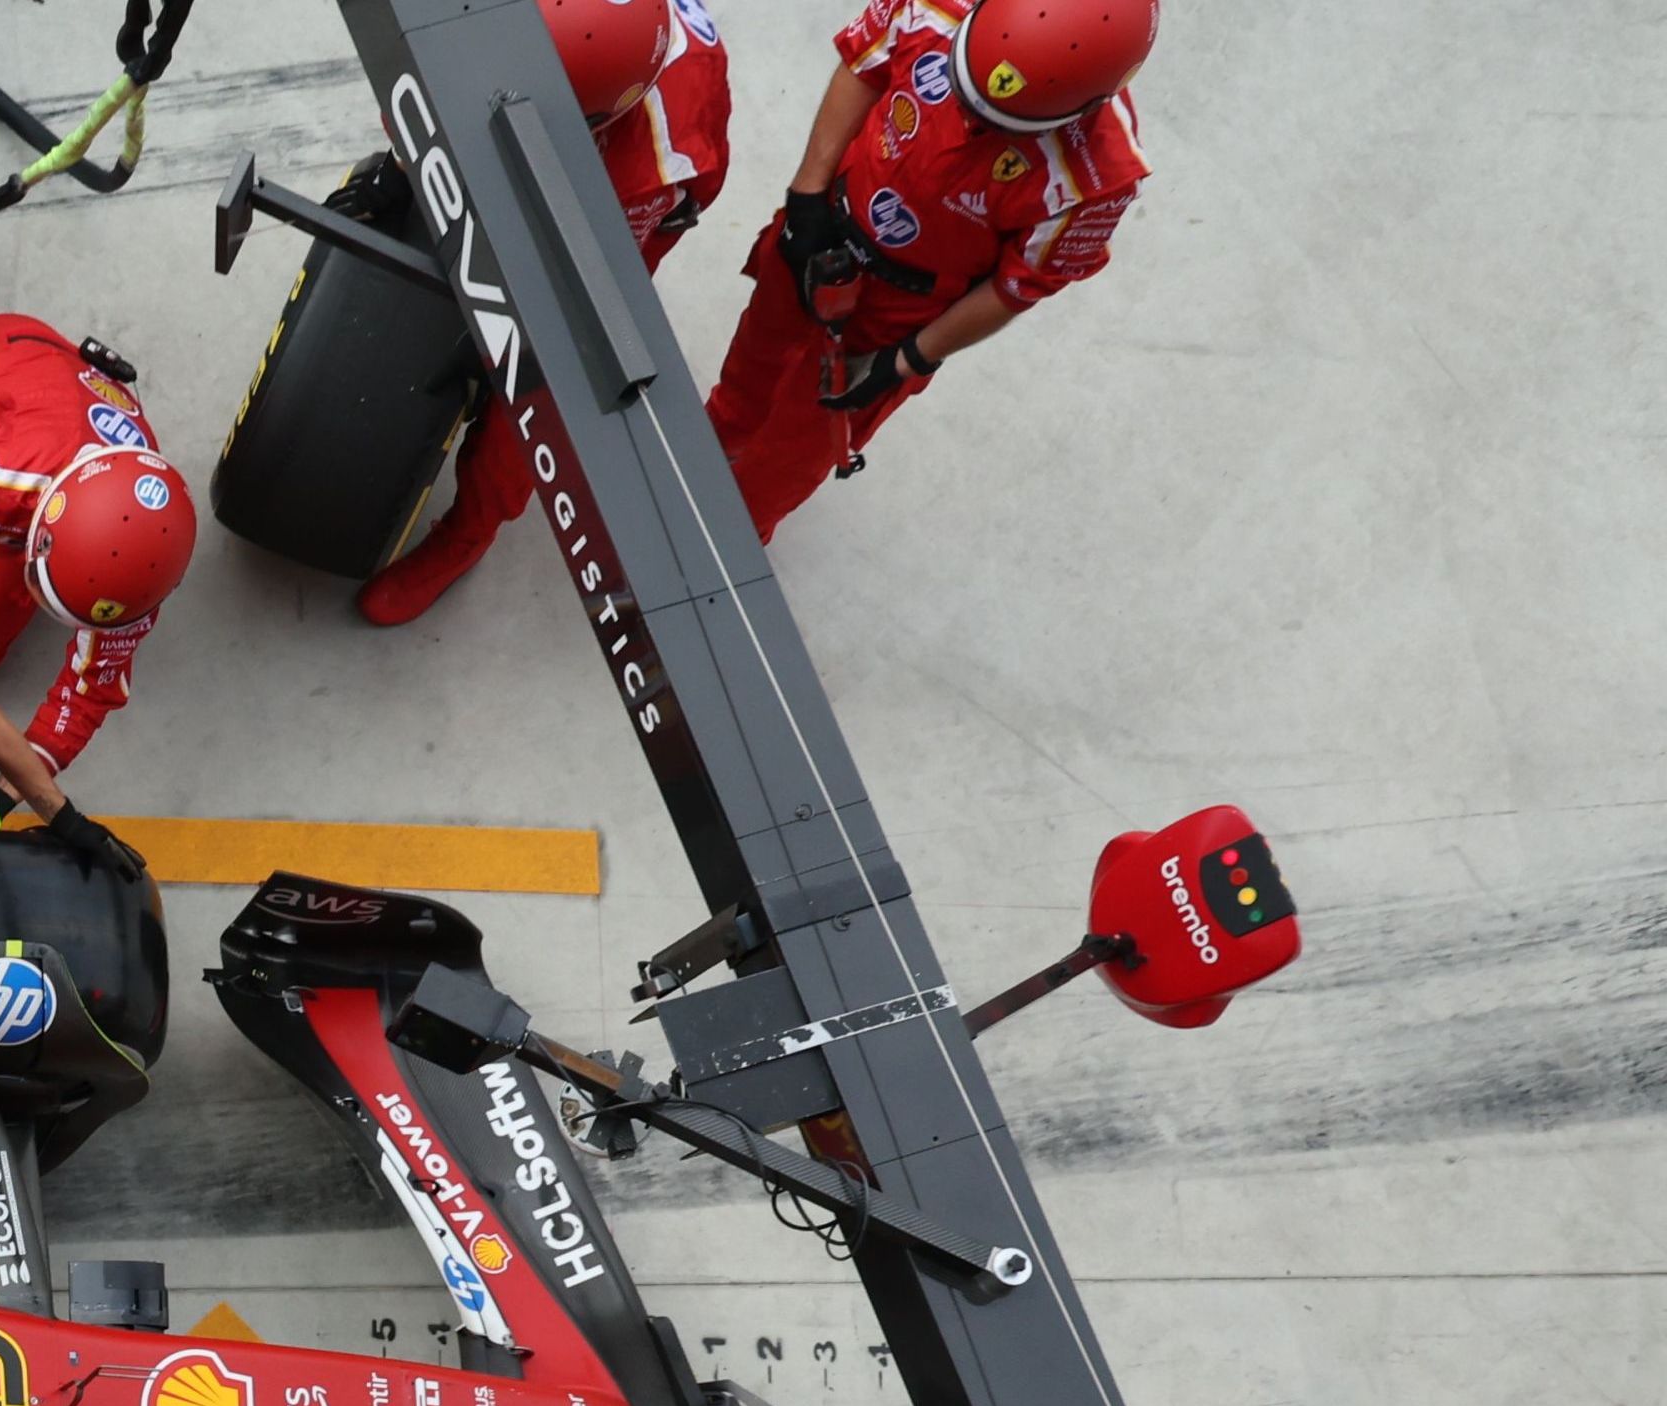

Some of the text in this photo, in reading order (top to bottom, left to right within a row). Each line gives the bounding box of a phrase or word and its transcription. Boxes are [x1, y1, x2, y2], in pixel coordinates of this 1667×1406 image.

[917, 57, 948, 101] hp
[875, 196, 916, 244] hp
[96, 411, 142, 447] hp
[139, 477, 166, 508] hp
[516, 404, 662, 736] LOGISTICS
[1161, 855, 1220, 965] brembo
[376, 1093, 487, 1239] V-Power
[478, 1064, 606, 1288] HCLSoftw
[372, 1318, 397, 1342] 5
[702, 1336, 728, 1354] 1
[758, 1336, 784, 1361] 2
[814, 1340, 837, 1362] 3
